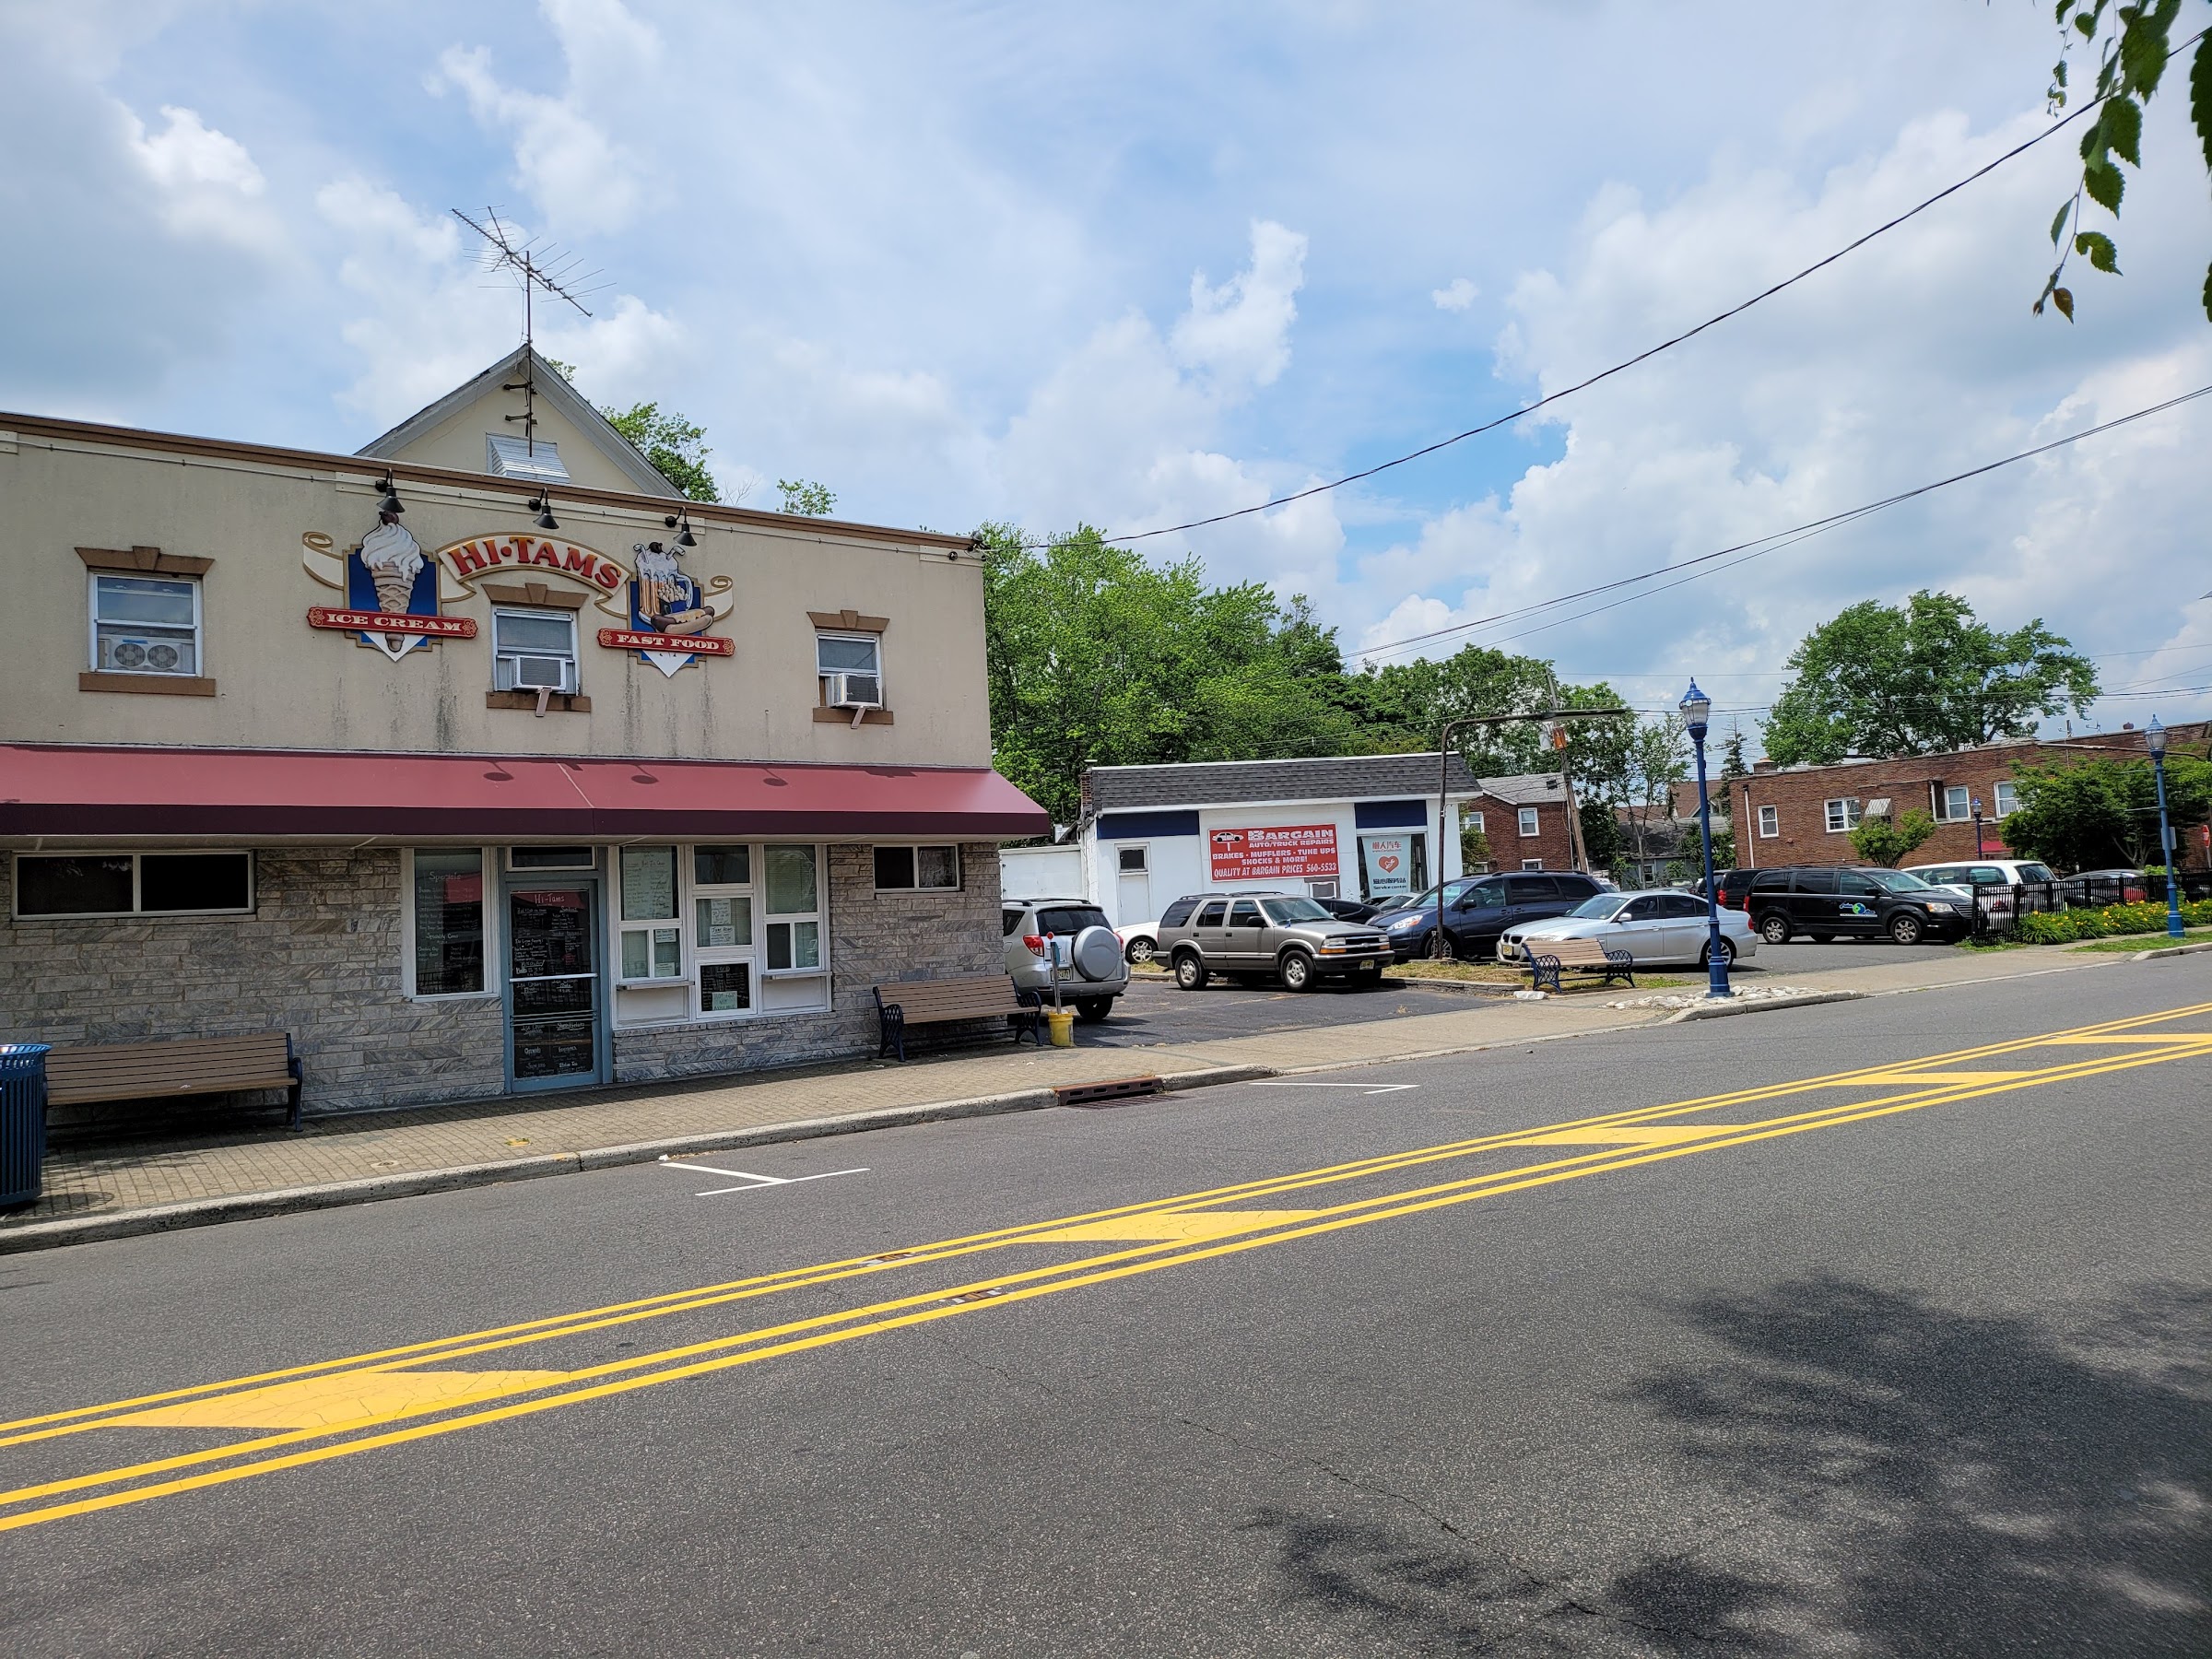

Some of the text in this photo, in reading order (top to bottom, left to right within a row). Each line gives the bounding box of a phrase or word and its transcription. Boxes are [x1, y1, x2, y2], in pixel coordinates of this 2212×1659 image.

[326, 613, 462, 632] ICE CREAM
[617, 634, 720, 650] FAST FOOD
[1247, 830, 1334, 841] BARGAIN
[1212, 852, 1244, 860] BRAKES
[1250, 850, 1291, 858] MUFFLERS
[1214, 863, 1336, 878] QUALITY AT BARGAIN PRICES 560-5533
[429, 871, 461, 882] Specials
[535, 893, 565, 904] Hi-Tams
